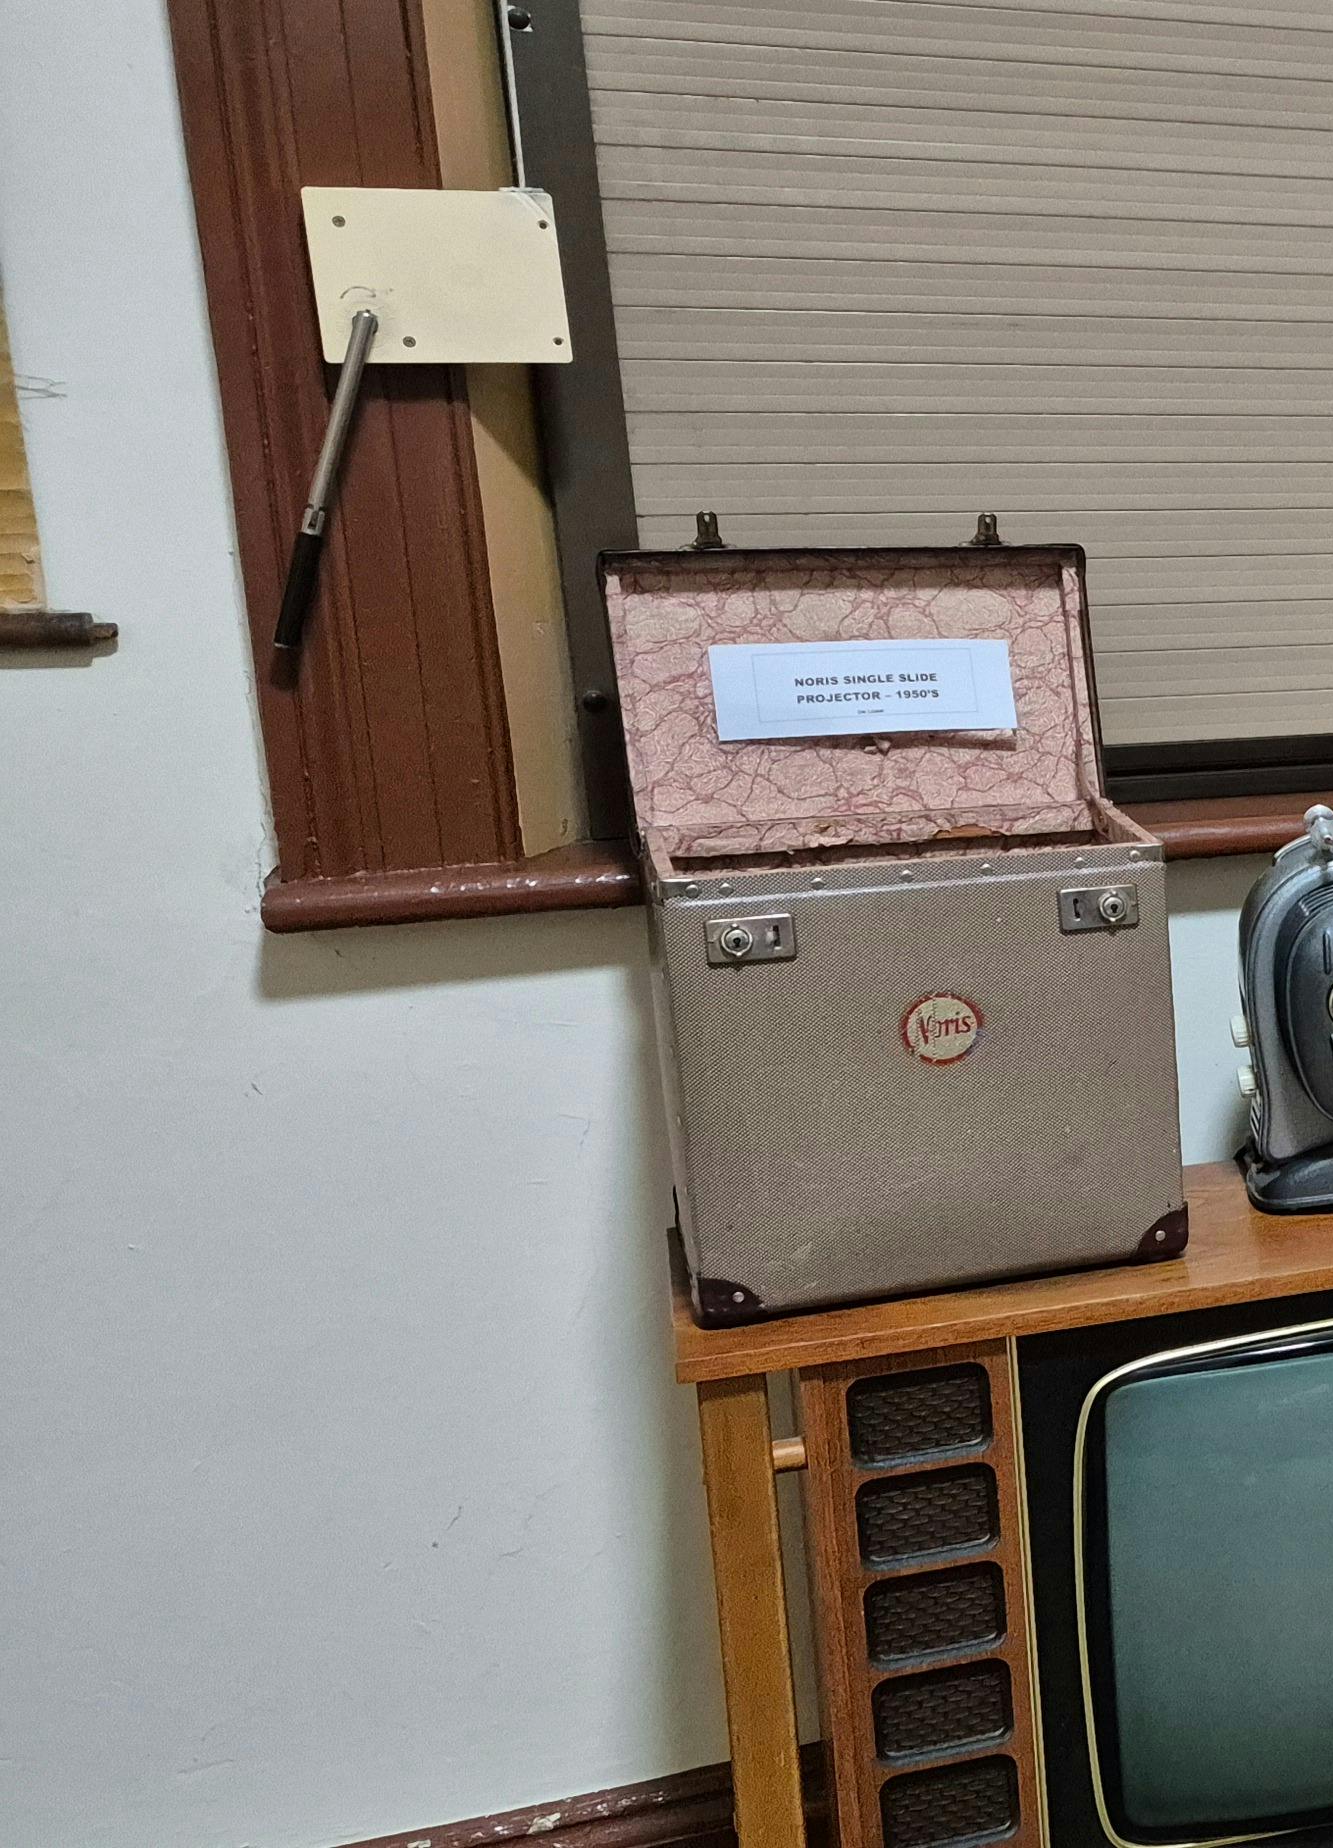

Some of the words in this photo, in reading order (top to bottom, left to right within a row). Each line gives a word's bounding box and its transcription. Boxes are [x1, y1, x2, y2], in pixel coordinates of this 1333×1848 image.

[795, 676, 839, 687] NORIS
[843, 673, 894, 685] SINGLE
[898, 672, 938, 683] SLIDE
[796, 690, 881, 704] PROJECTOR
[896, 689, 939, 700] 1950'S
